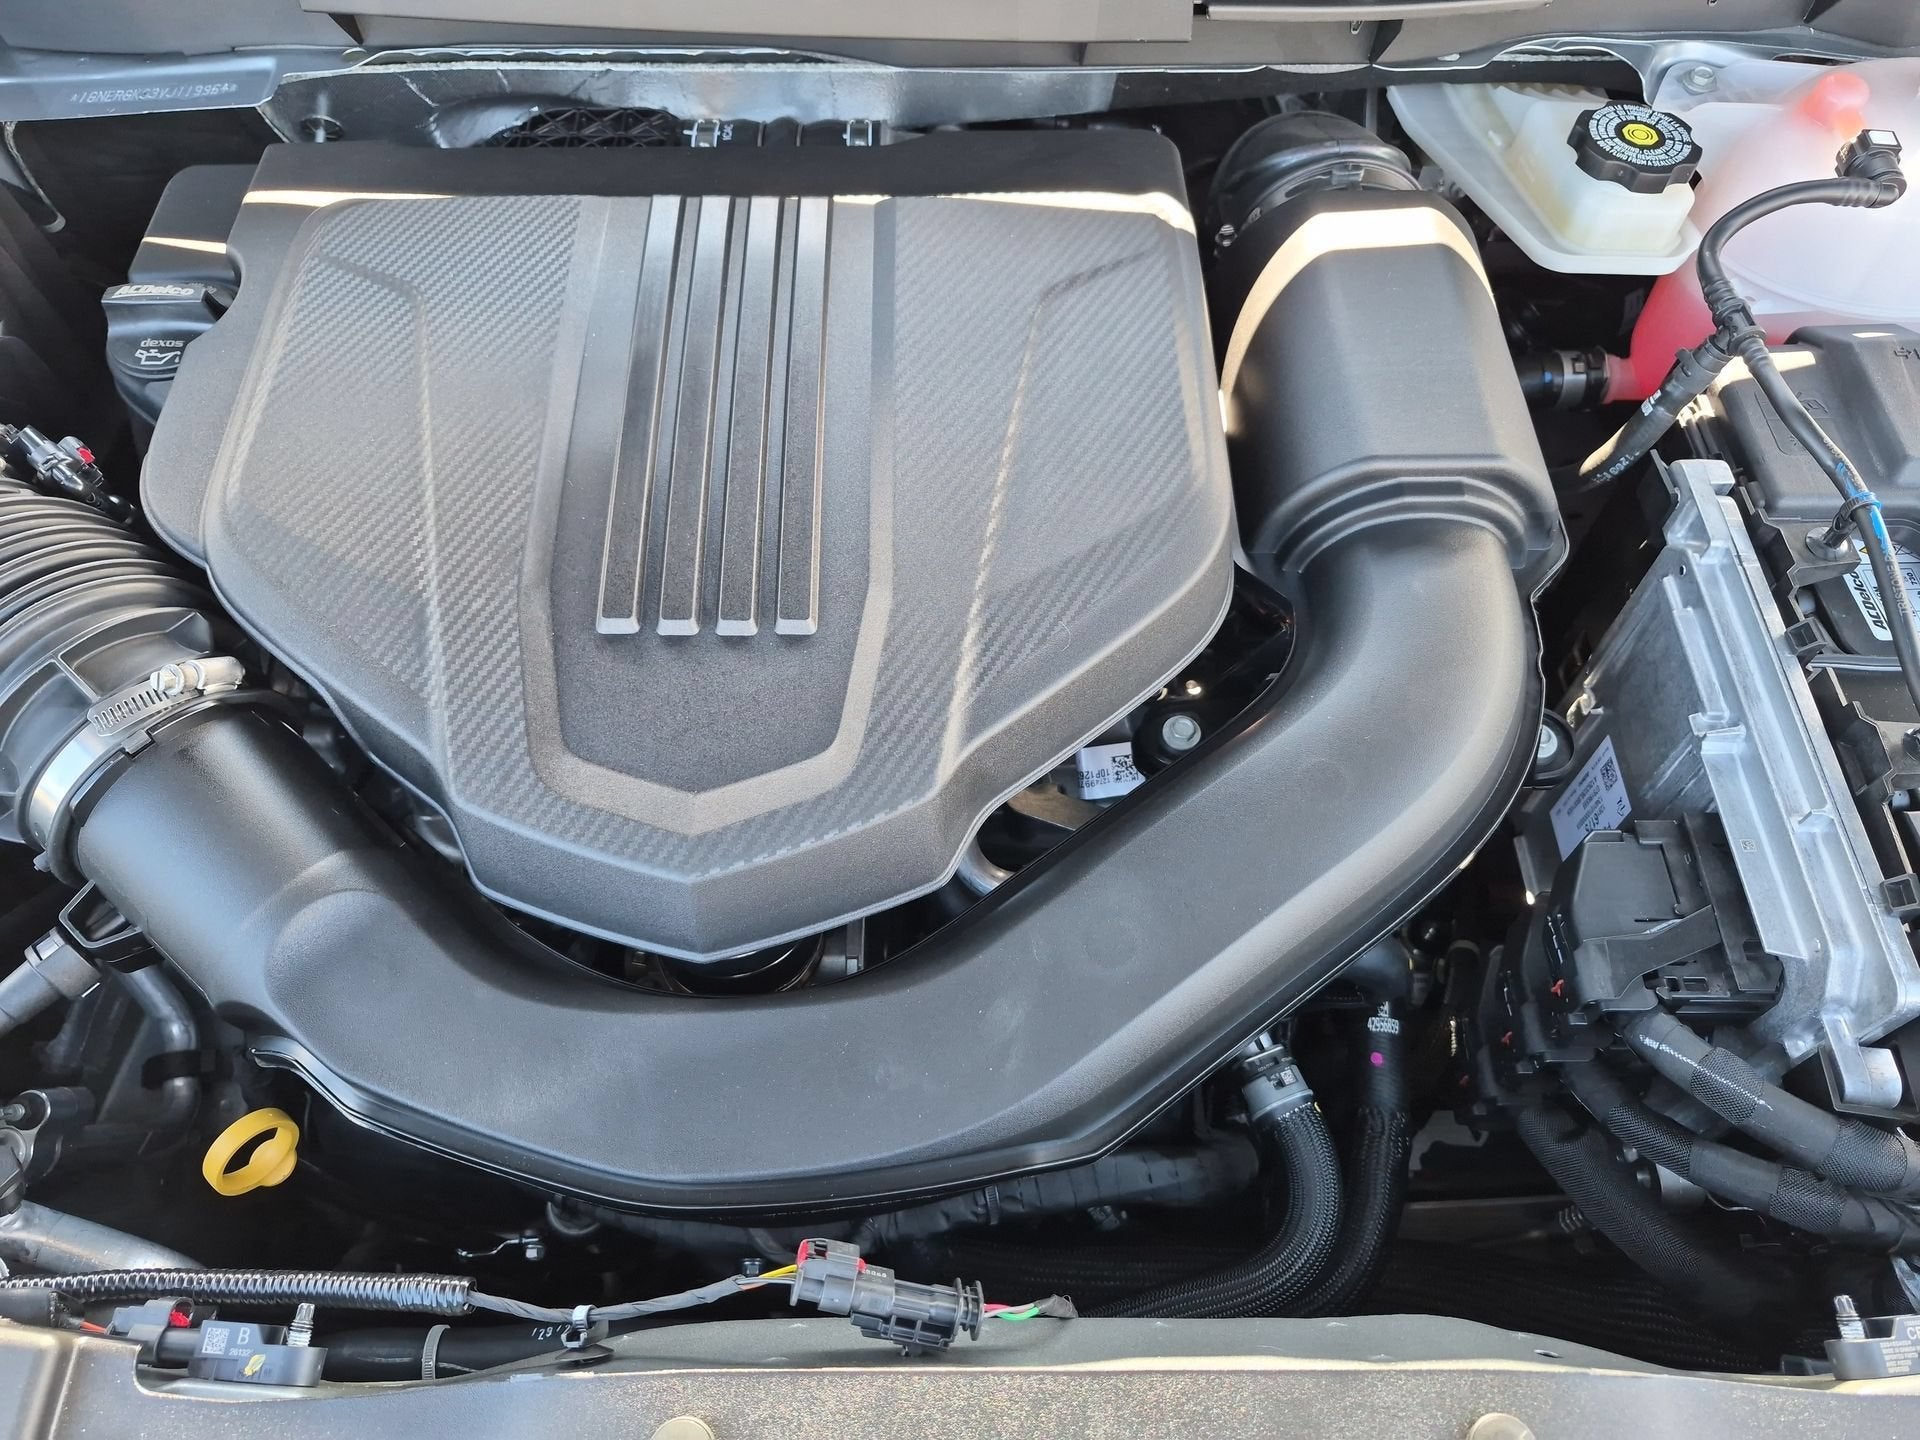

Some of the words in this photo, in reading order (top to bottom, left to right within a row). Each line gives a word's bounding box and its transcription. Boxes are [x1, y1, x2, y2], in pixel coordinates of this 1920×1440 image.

[113, 285, 194, 296] ACDelco
[140, 338, 185, 347] dexos
[1849, 571, 1888, 631] ACDelco
[237, 1327, 250, 1344] B
